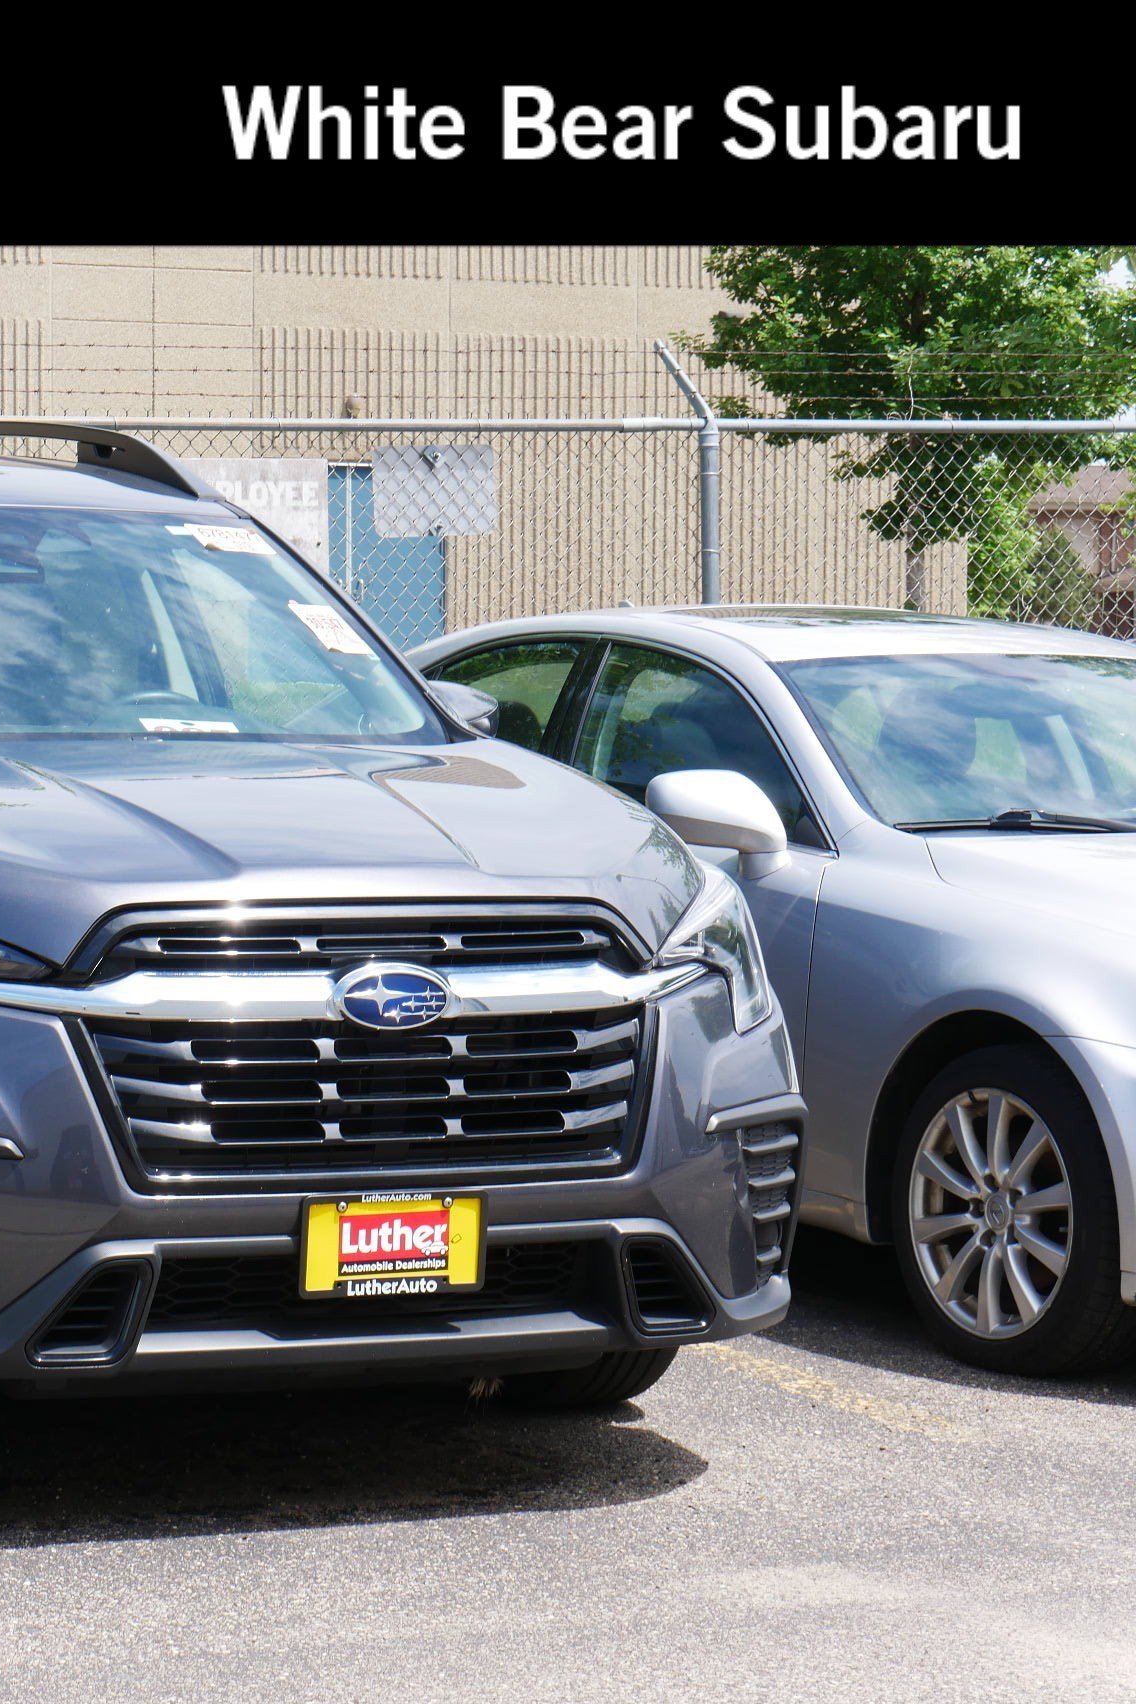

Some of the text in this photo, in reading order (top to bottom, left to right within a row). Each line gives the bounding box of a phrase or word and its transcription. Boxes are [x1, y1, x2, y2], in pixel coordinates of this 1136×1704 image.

[210, 479, 320, 507] PLOYEE
[361, 1192, 432, 1204] LutherAuto.com
[341, 1218, 448, 1255] Luther
[340, 1256, 446, 1274] Automobile Dealerships
[346, 1278, 438, 1297] LutherAuto
